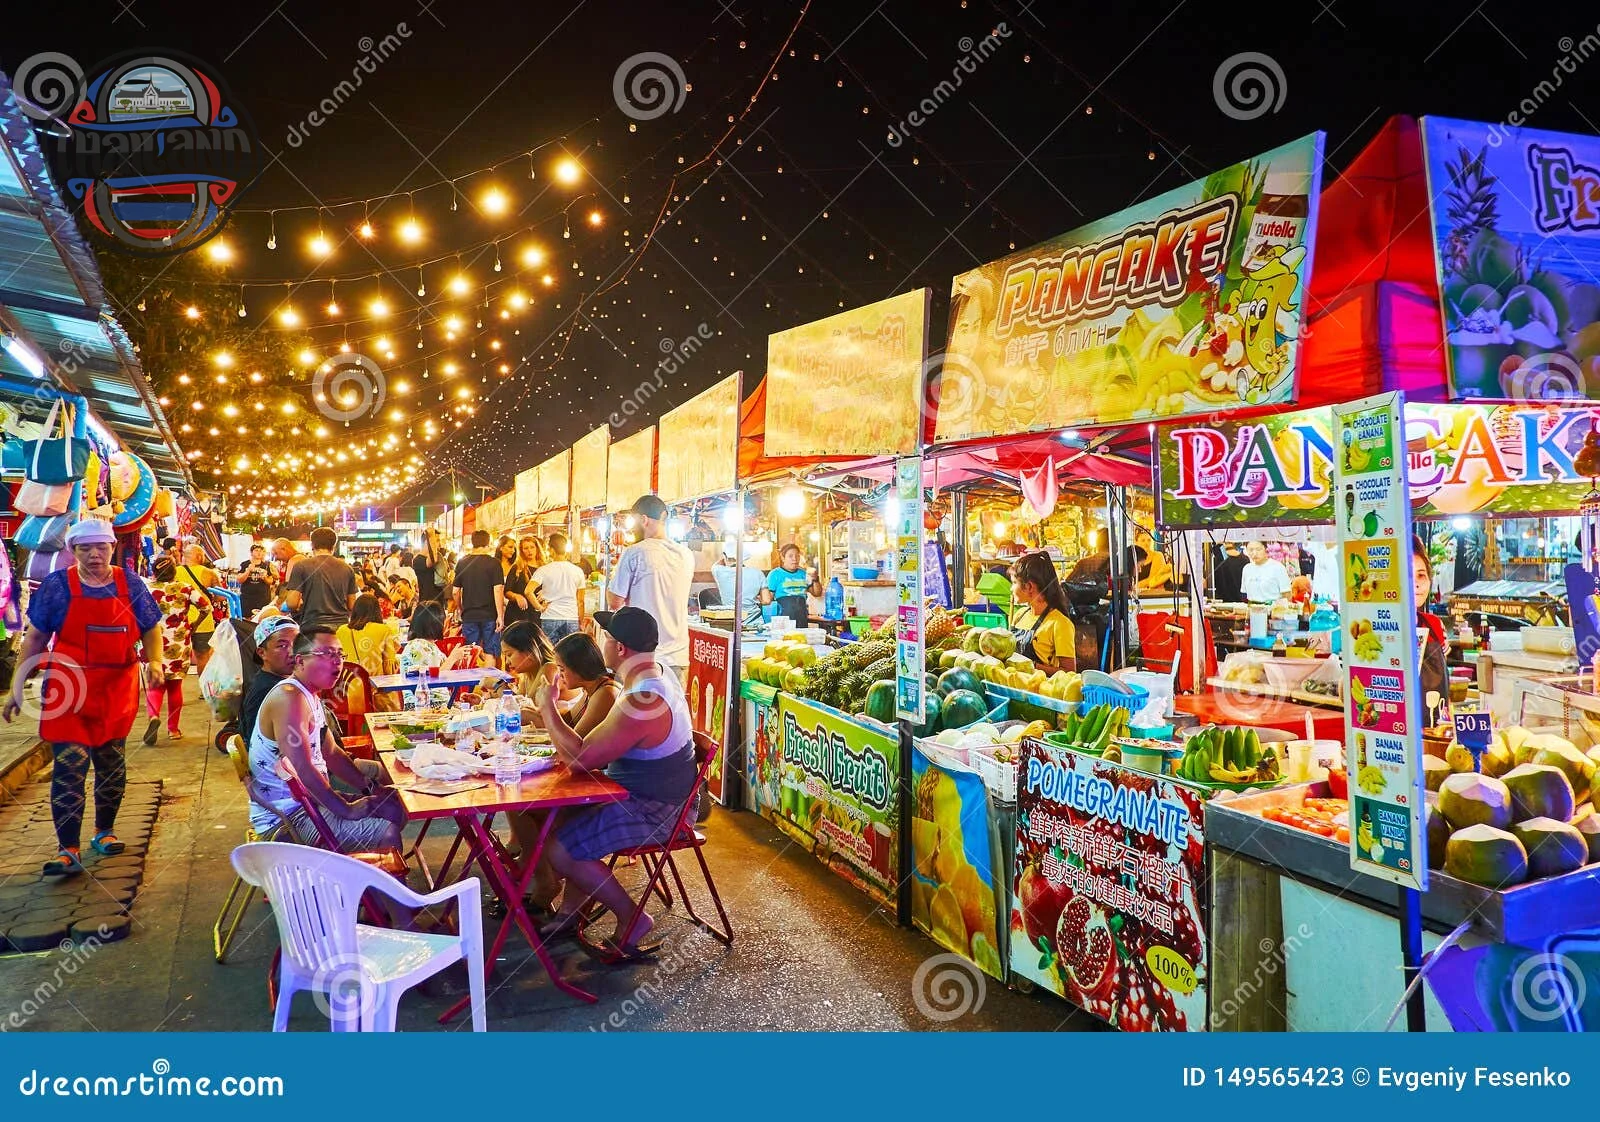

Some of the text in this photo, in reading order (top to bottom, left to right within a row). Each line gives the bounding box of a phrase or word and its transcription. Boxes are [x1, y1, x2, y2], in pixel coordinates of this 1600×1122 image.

[1529, 146, 1600, 229] Fr
[1255, 220, 1297, 239] nutella
[997, 202, 1234, 333] PANCAKE
[1353, 413, 1388, 429] CHOCOLATE
[1380, 457, 1391, 467] 60
[1355, 477, 1391, 491] CHOCOLATE
[1359, 489, 1389, 501] COCONUT
[1367, 546, 1391, 557] MANGO
[1368, 558, 1390, 569] HONEY
[1383, 591, 1397, 600] 100
[1377, 609, 1391, 620] EGG
[1500, 605, 1522, 615] PAINT
[1372, 620, 1400, 632] BANANA
[1372, 676, 1400, 689] BANANA
[1393, 723, 1404, 733] 60
[1456, 716, 1476, 731] 50
[1375, 738, 1404, 752] BANANA
[785, 715, 887, 805] Fresh Fruit
[1374, 750, 1405, 764] CARAMEL
[1028, 760, 1188, 847] POMEGRANATE
[1396, 795, 1407, 804] 60
[1379, 810, 1408, 827] BANANA
[1029, 809, 1191, 901] 鲜榨新鲜石榴汁
[1398, 859, 1410, 868] 60
[1043, 853, 1174, 935] 最好的健康饮品
[1155, 953, 1193, 987] 100%
